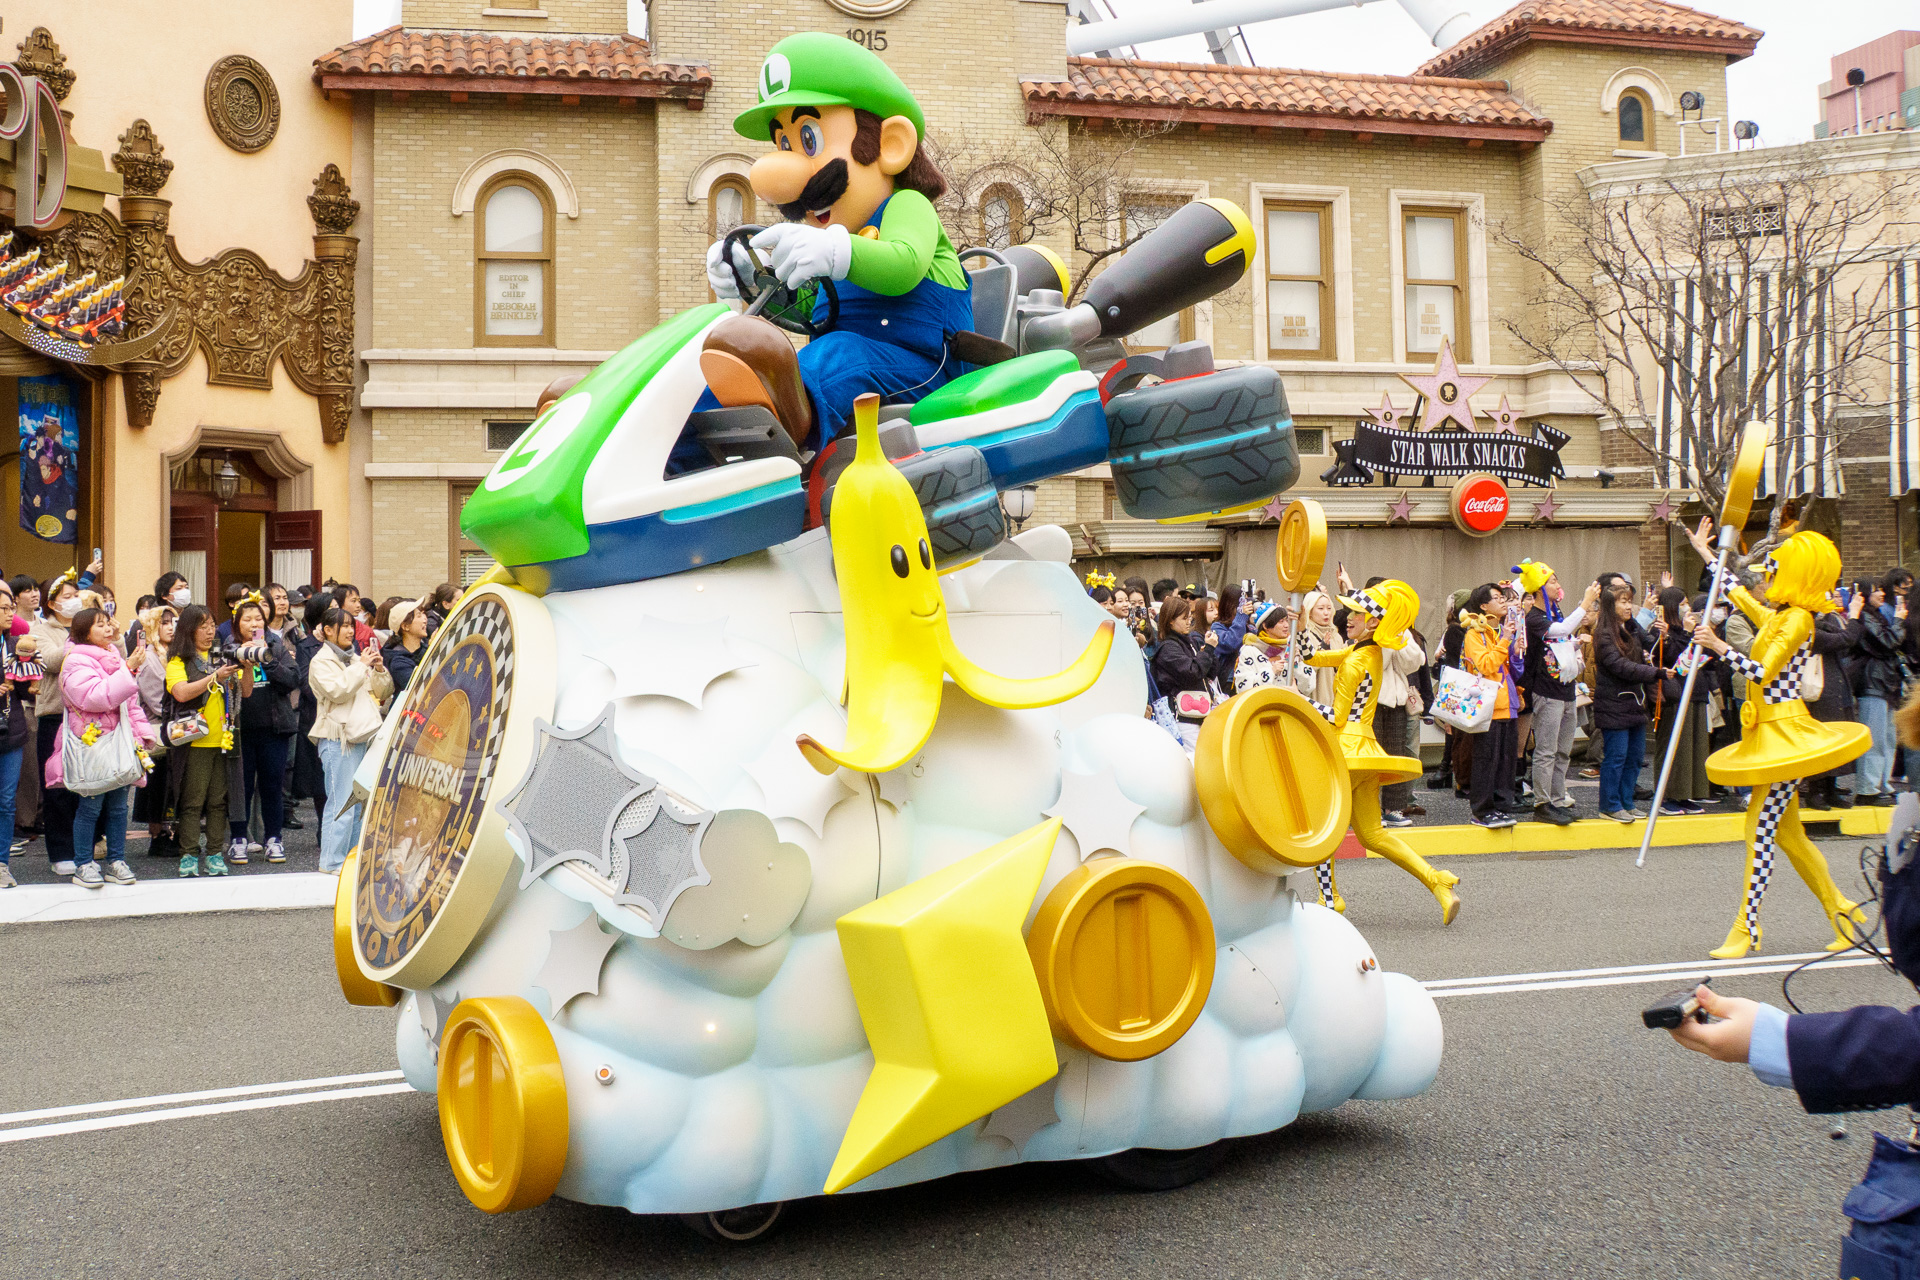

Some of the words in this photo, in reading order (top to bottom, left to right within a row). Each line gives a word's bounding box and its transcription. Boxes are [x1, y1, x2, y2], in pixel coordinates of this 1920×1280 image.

[764, 62, 785, 96] L
[498, 274, 530, 282] EDITOR
[509, 282, 519, 290] IN
[501, 290, 527, 298] CHIEF
[492, 302, 537, 311] DEBORAH
[490, 311, 539, 320] BRINKLEY
[496, 408, 560, 475] L
[1390, 440, 1425, 466] STAR
[1430, 442, 1469, 466] WALK
[1473, 442, 1527, 469] SNACKS
[1464, 496, 1506, 514] Coca-Cola
[397, 752, 467, 805] UNIVERSAL
